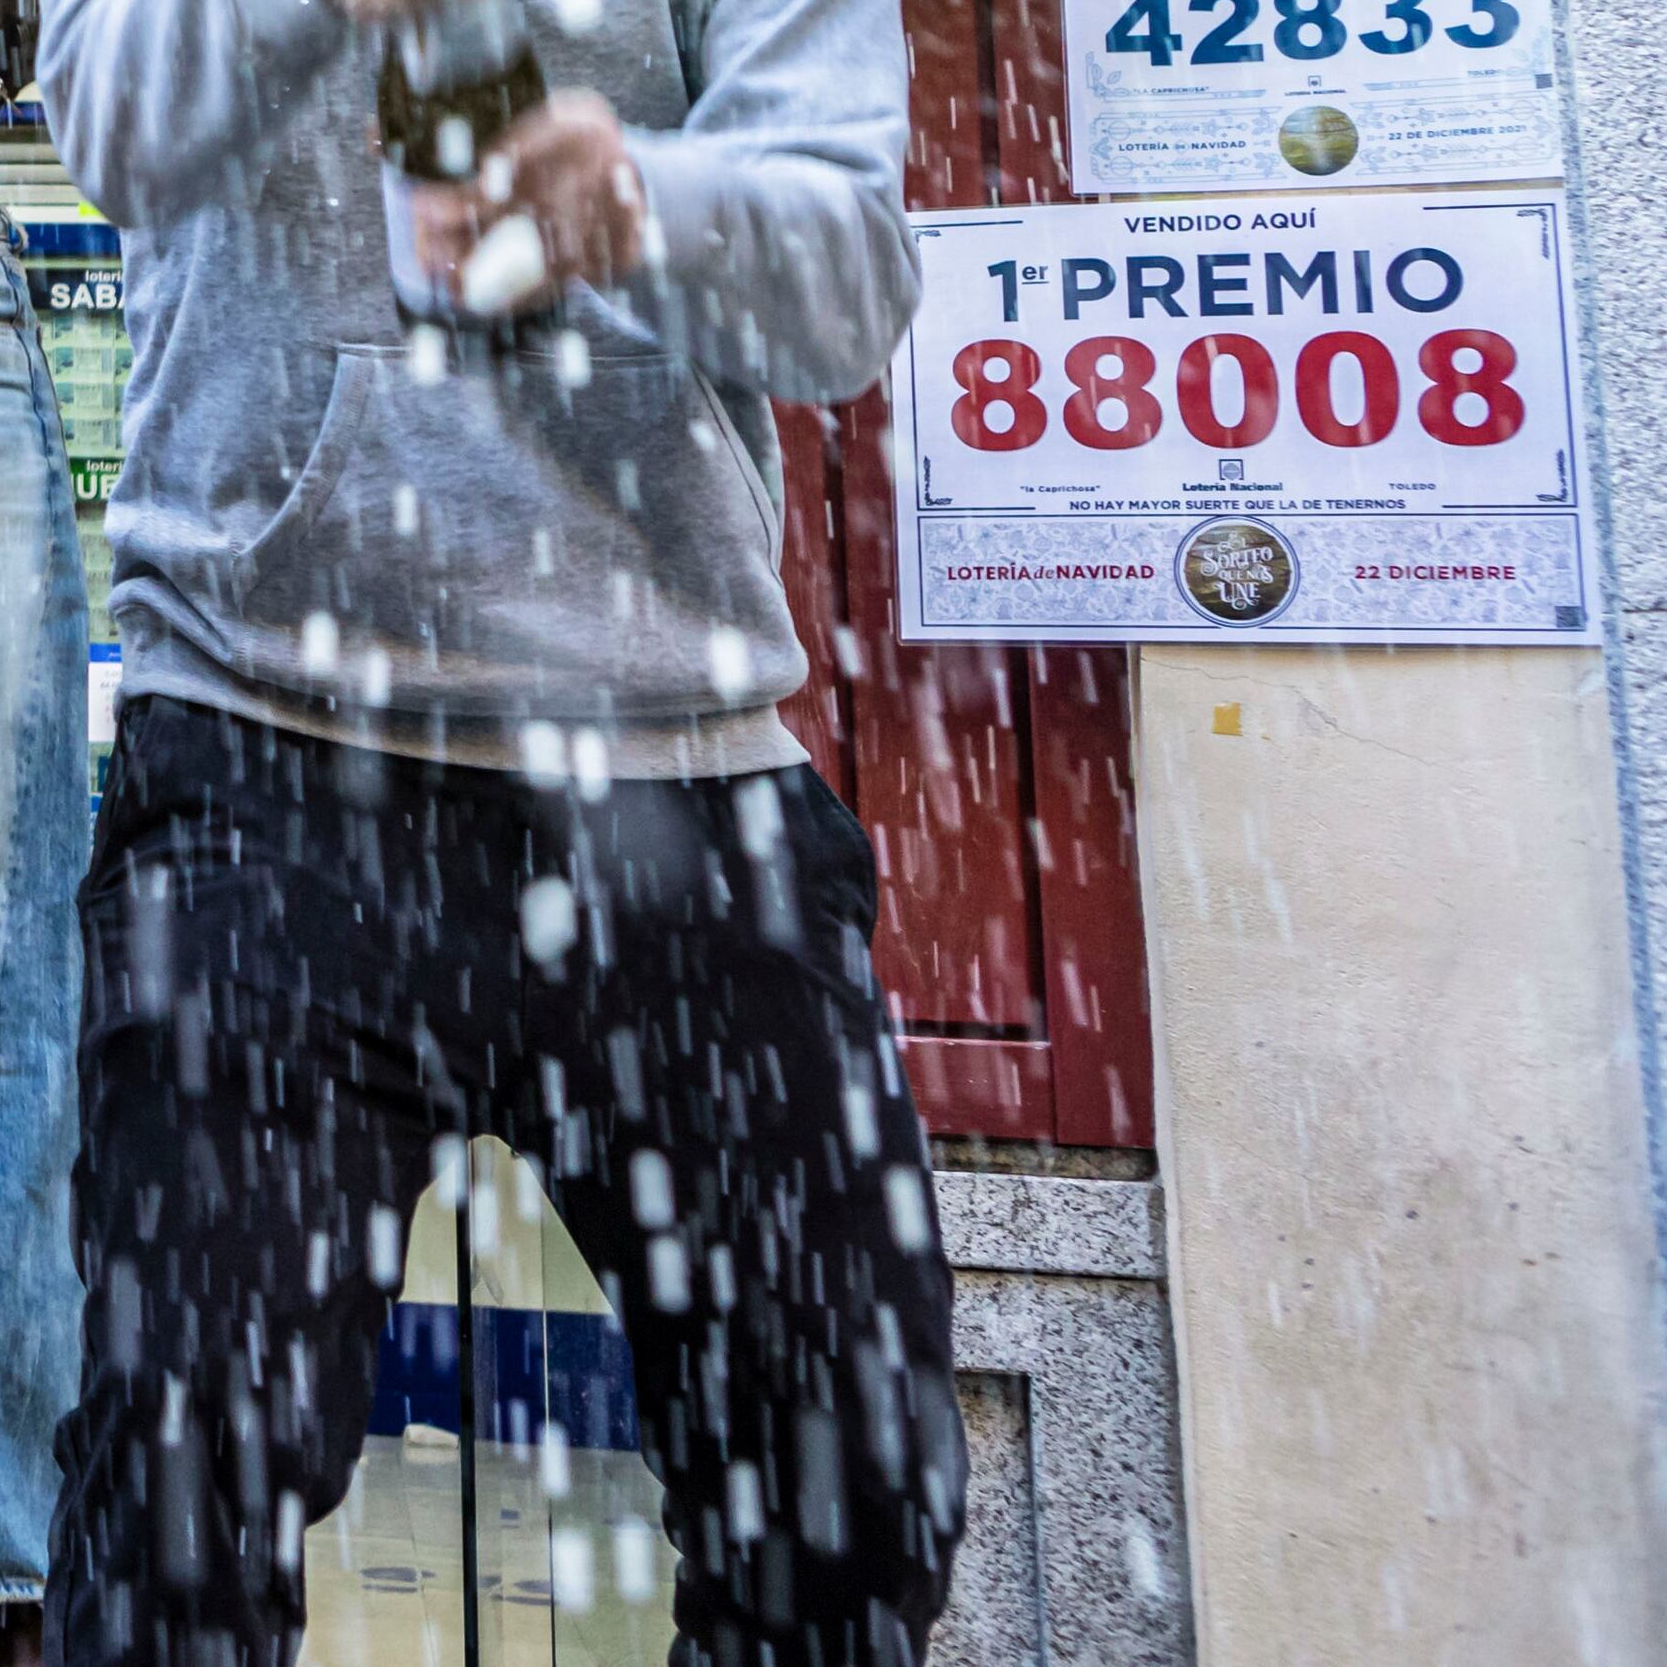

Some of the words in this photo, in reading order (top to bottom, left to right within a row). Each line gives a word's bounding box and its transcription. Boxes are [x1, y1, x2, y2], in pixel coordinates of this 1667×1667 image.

[1389, 132, 1402, 141] 22
[1406, 131, 1423, 140] DE
[1427, 126, 1495, 139] DICIEMBRE
[1118, 140, 1170, 152] LOTERÍA
[1191, 139, 1247, 151] NAVIDAD
[1124, 213, 1242, 234] VENDIDO
[1250, 207, 1317, 232] AQUÍ
[1064, 247, 1464, 320] PREMIO
[950, 327, 1526, 453] 88008
[1182, 482, 1227, 492] Lotería
[1230, 481, 1284, 492] Nacional
[1388, 482, 1437, 492] TOLEDO
[1069, 500, 1091, 511] NO
[1094, 500, 1125, 512] HAY
[1128, 499, 1181, 511] MAYOR
[1185, 499, 1241, 511] SUERTE
[1245, 499, 1276, 511] QUE
[1279, 499, 1299, 510] LA
[1302, 499, 1322, 510] DE
[1326, 498, 1406, 511] TENERNOS
[947, 560, 1032, 582] LOTERÍA
[1055, 562, 1155, 581] NAVIDAD
[1354, 564, 1381, 581] 22
[1387, 563, 1517, 582] DICIEMBRE
